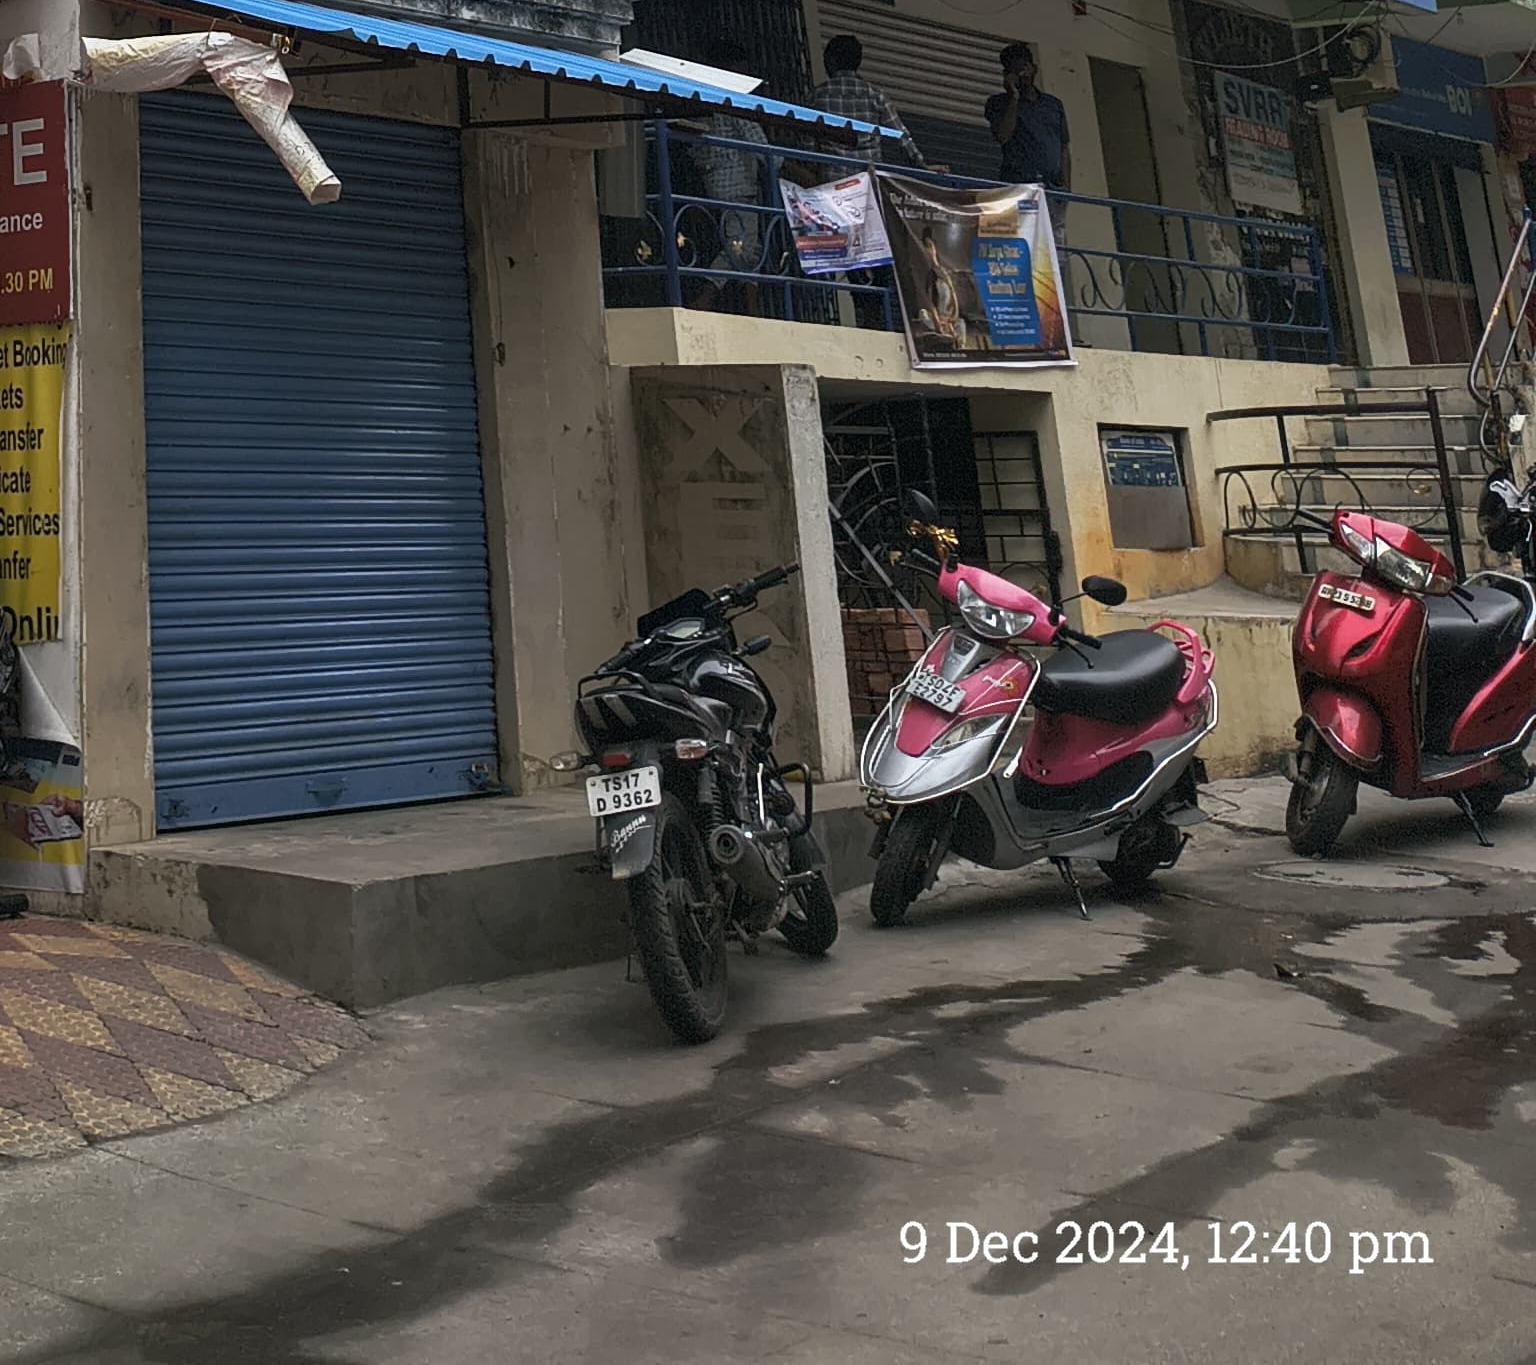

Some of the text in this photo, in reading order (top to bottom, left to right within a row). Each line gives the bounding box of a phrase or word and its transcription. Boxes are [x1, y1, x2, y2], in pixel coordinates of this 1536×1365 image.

[28, 268, 53, 291] PM
[601, 773, 639, 792] TS17
[597, 789, 653, 812] D 9362
